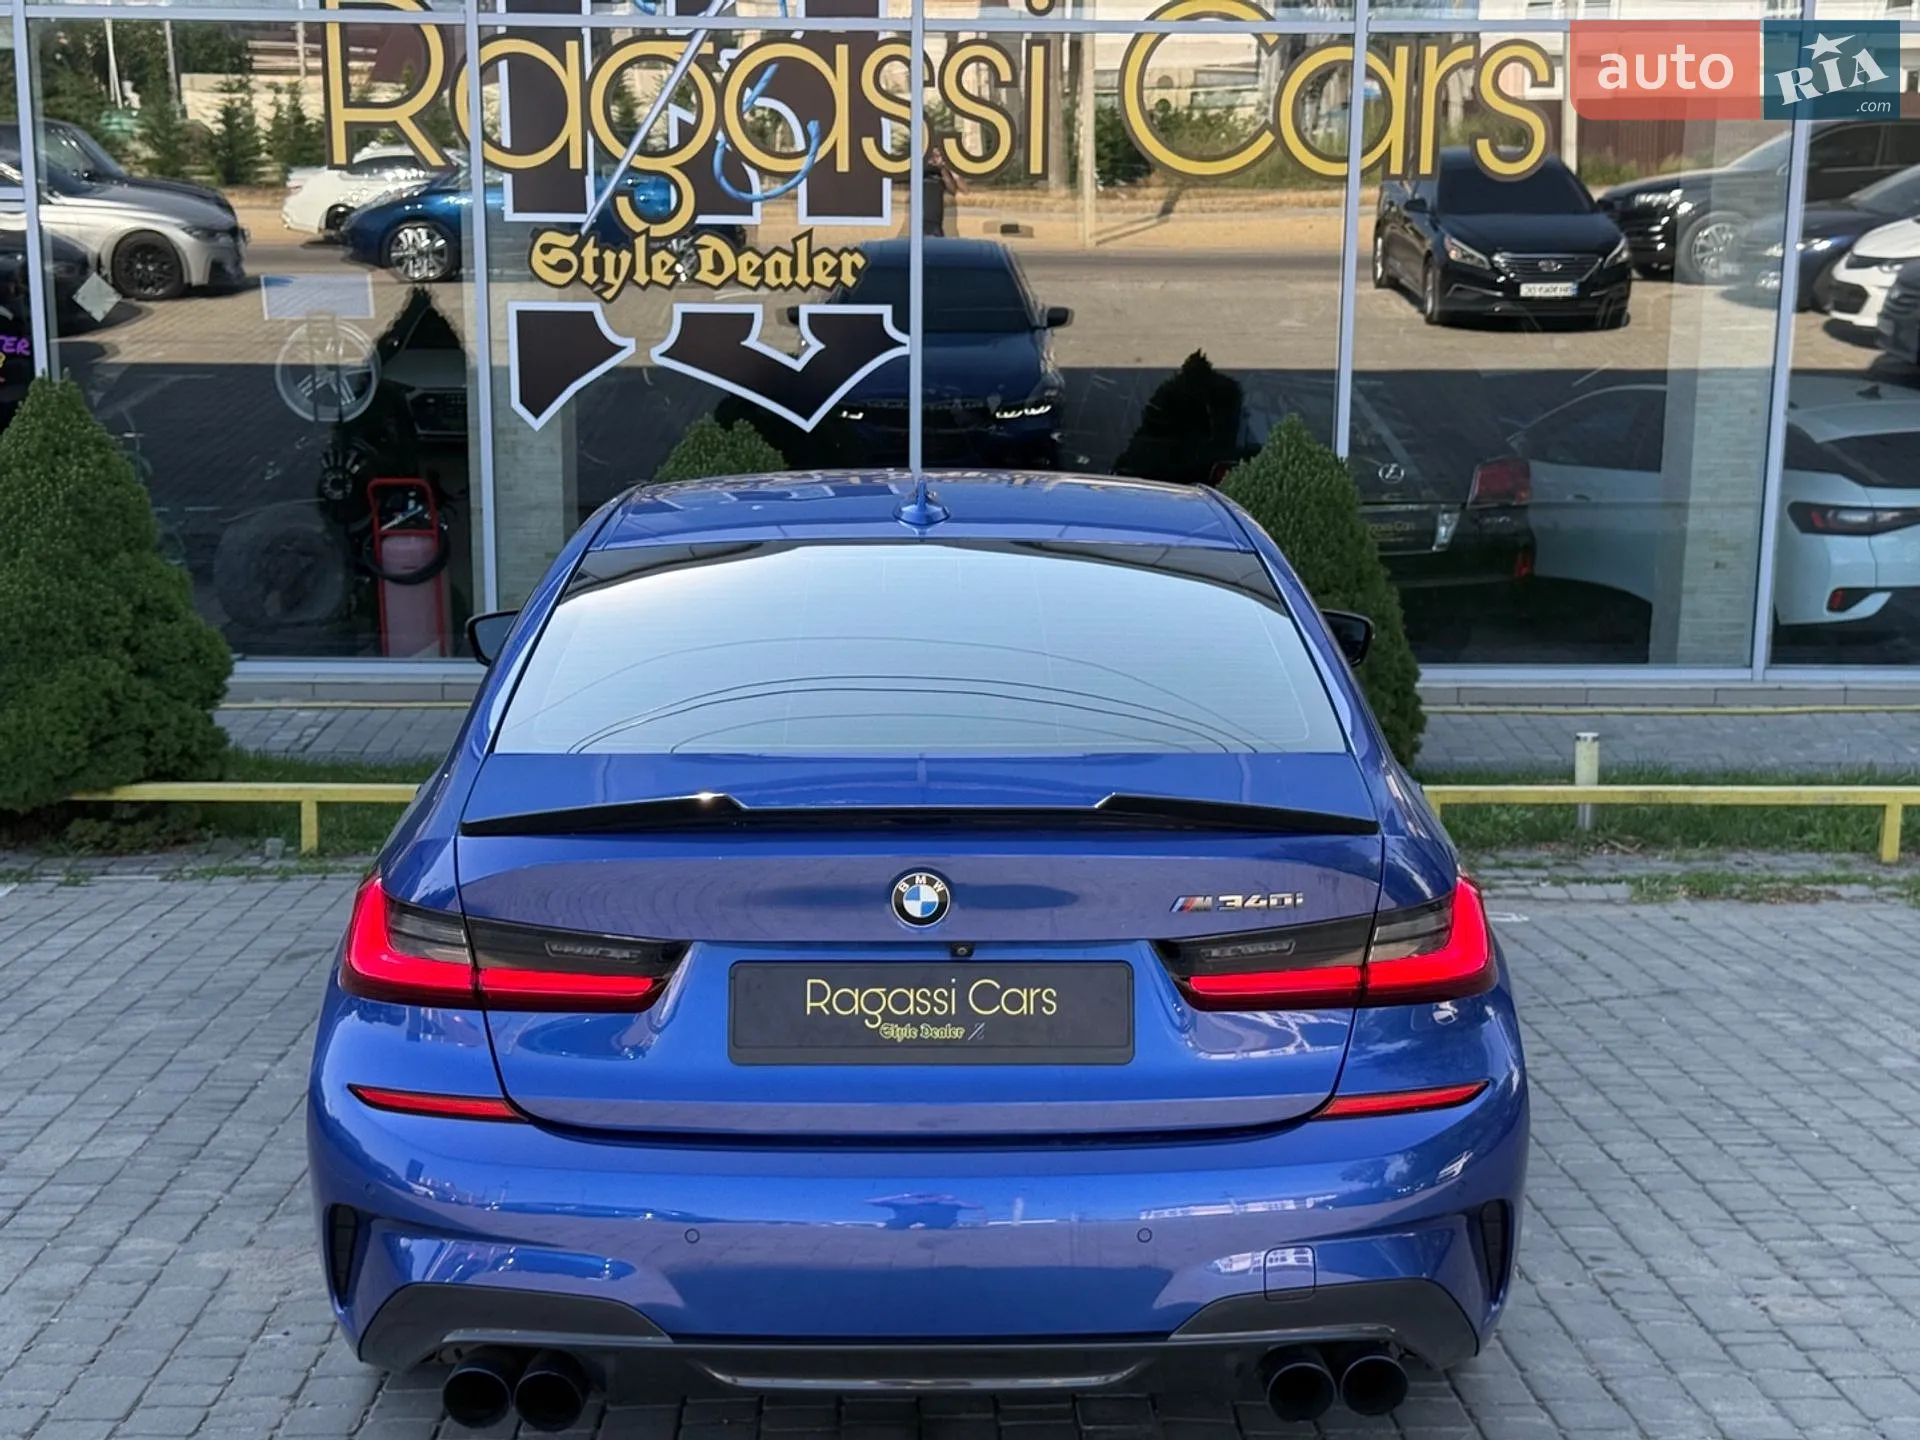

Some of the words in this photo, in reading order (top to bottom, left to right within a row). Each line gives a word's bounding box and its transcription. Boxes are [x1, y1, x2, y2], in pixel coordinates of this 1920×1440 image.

[322, 0, 1049, 238] Ragassi
[1118, 0, 1554, 182] Cars
[529, 228, 679, 302] Style
[692, 228, 866, 291] Dealer
[898, 875, 946, 893] BMW
[806, 978, 957, 1029] Ragassi
[968, 978, 1057, 1016] Cars
[919, 1022, 965, 1040] Dealer
